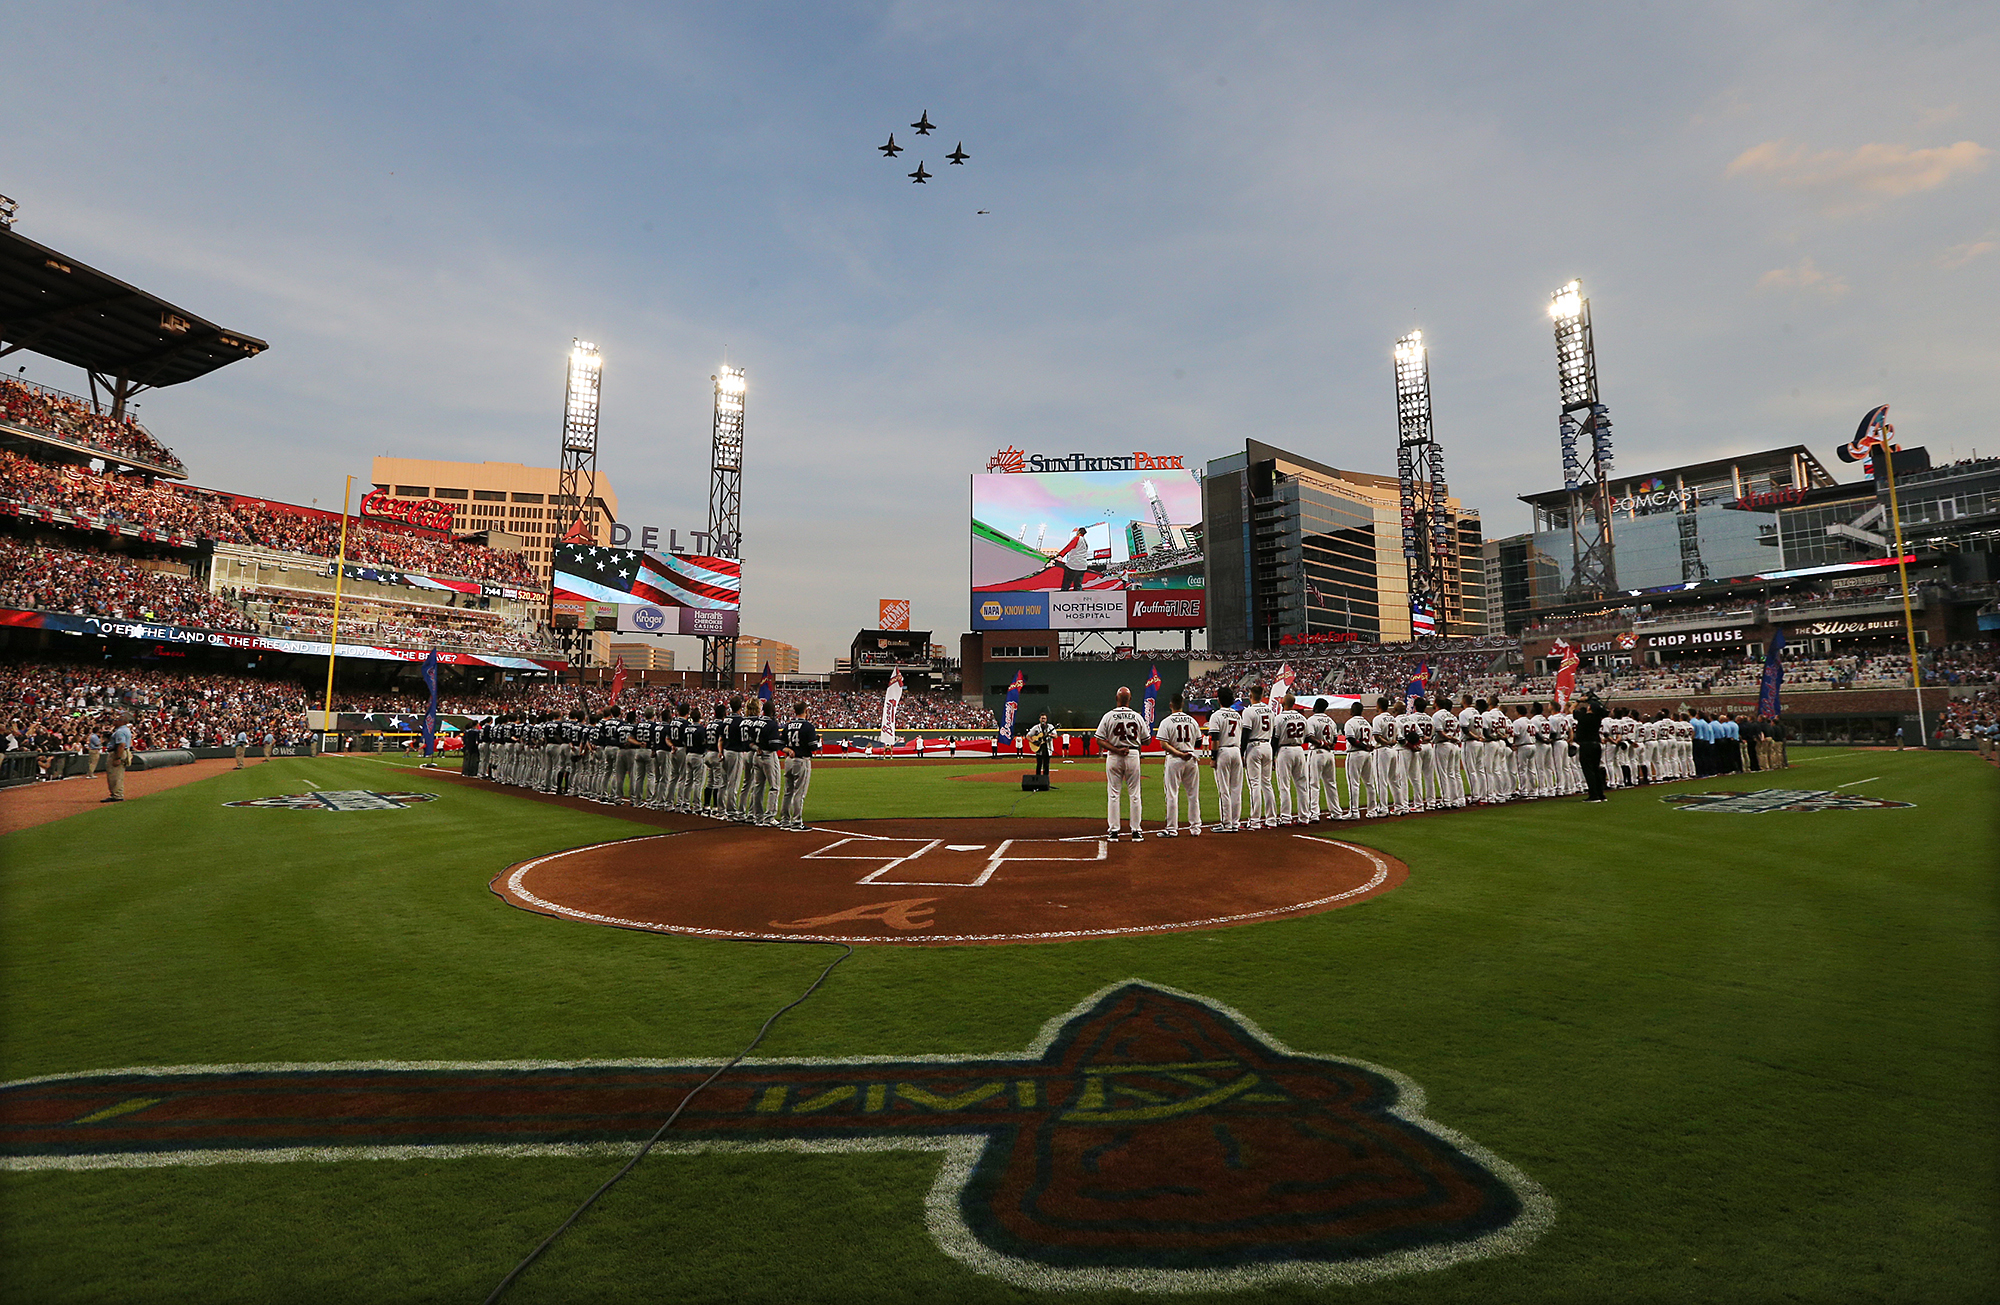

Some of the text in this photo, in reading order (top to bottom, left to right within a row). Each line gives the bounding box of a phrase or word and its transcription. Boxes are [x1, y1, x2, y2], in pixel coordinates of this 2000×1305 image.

[1133, 451, 1184, 470] PARK
[1612, 486, 1700, 513] COMCAST
[1736, 486, 1809, 511] xfinity
[0, 503, 19, 517] 29
[38, 509, 53, 523] 31
[73, 516, 91, 530] 35
[106, 524, 120, 536] 41
[139, 529, 156, 543] 44
[168, 536, 183, 548] 47
[610, 523, 735, 556] DELTA
[879, 600, 910, 629] HOME
[882, 602, 895, 615] THE
[983, 605, 1041, 616] NAPA KNOW HOW
[1052, 602, 1124, 612] NORTHSIDE
[1165, 600, 1201, 616] TIRE
[636, 609, 663, 629] Kroger
[891, 611, 910, 630] DEPOT
[1795, 620, 1899, 636] THE Silver BULLET
[169, 628, 205, 642] LAND
[207, 634, 224, 644] OF
[227, 635, 250, 647] THE
[252, 637, 281, 650] FREE
[282, 641, 310, 652] AND
[339, 646, 374, 657] HOME
[376, 648, 391, 658] OF
[394, 650, 416, 660] THE
[1296, 631, 1358, 645] State Farm
[1648, 630, 1743, 647] CHOP HOUSE
[1581, 641, 1611, 652] LIGHT
[1727, 705, 1756, 713] BELOW
[1113, 713, 1136, 721] SNITKER
[1261, 715, 1269, 732] 5
[605, 725, 616, 738] 30
[636, 729, 650, 741] 22
[670, 727, 679, 740] 10
[724, 725, 729, 739] 4
[755, 728, 760, 743] 7
[1113, 722, 1138, 740] 43
[1176, 724, 1190, 742] 11
[1228, 720, 1237, 737] 7
[1287, 722, 1305, 738] 22
[1323, 724, 1330, 740] 4
[1360, 727, 1370, 742] 13
[1387, 723, 1394, 738] 8
[655, 731, 660, 744] 8
[686, 734, 693, 747] 11
[787, 731, 800, 747] 14
[280, 747, 296, 755] WISE
